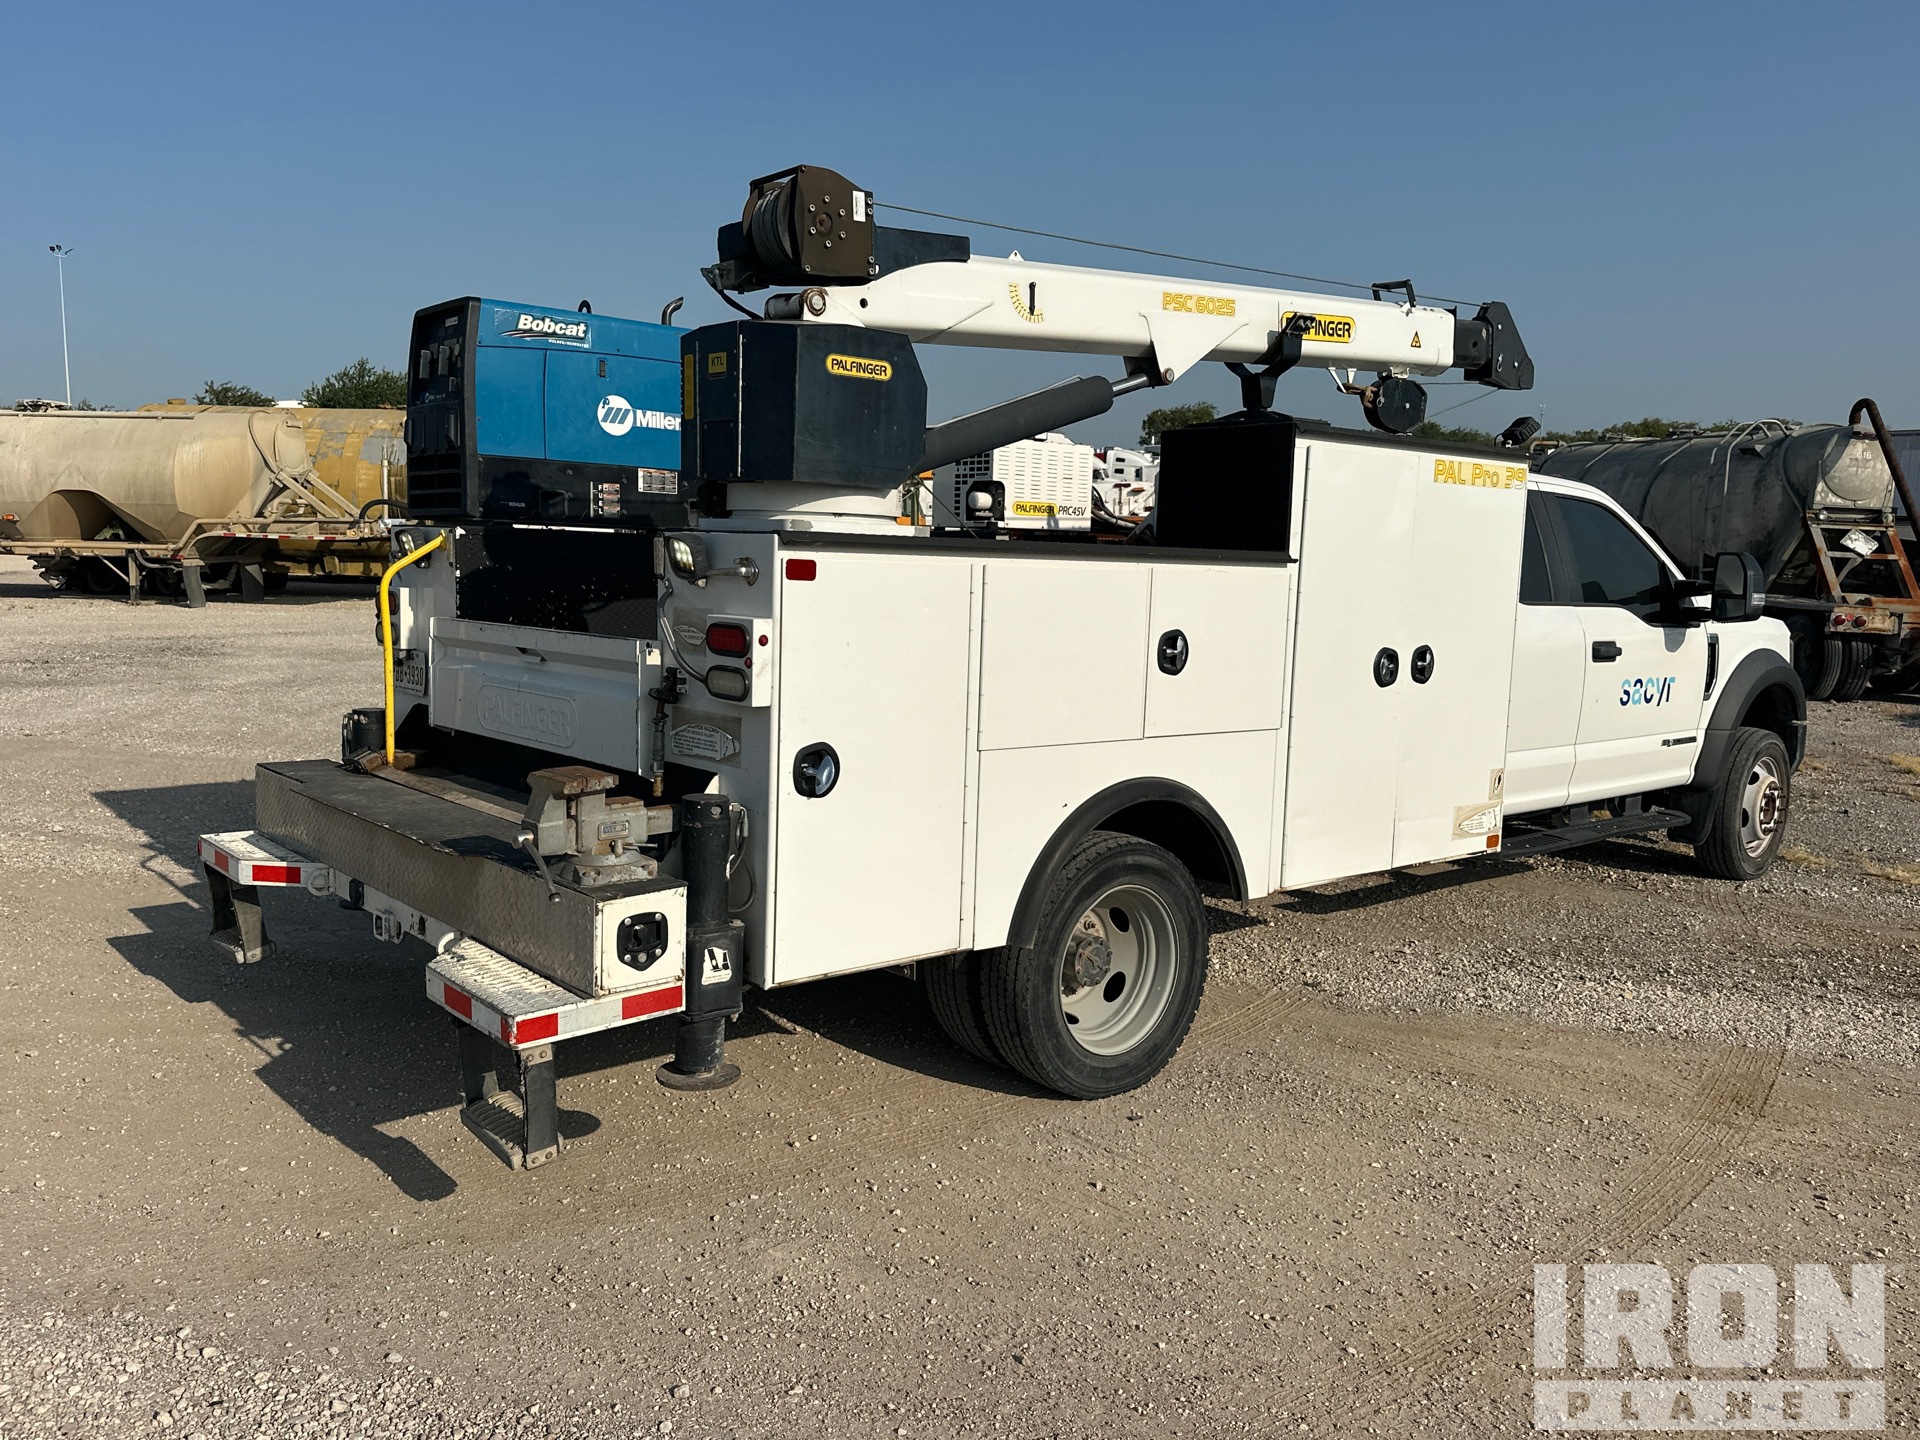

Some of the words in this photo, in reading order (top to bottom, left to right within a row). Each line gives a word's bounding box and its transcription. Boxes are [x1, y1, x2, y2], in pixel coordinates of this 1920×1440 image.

[1163, 293, 1192, 312] PSC
[1196, 297, 1235, 316] 6025
[517, 314, 587, 338] Bobcat
[711, 356, 724, 367] KTL
[831, 358, 888, 377] PALFINGER
[636, 409, 681, 431] Miller
[1434, 460, 1466, 484] PAL
[1471, 464, 1499, 488] Pro
[1504, 467, 1527, 490] 39
[1015, 503, 1055, 515] PALFINGER
[1057, 505, 1087, 517] PRC45V
[1619, 677, 1676, 707] sacyr
[483, 691, 571, 738] PALFINGER
